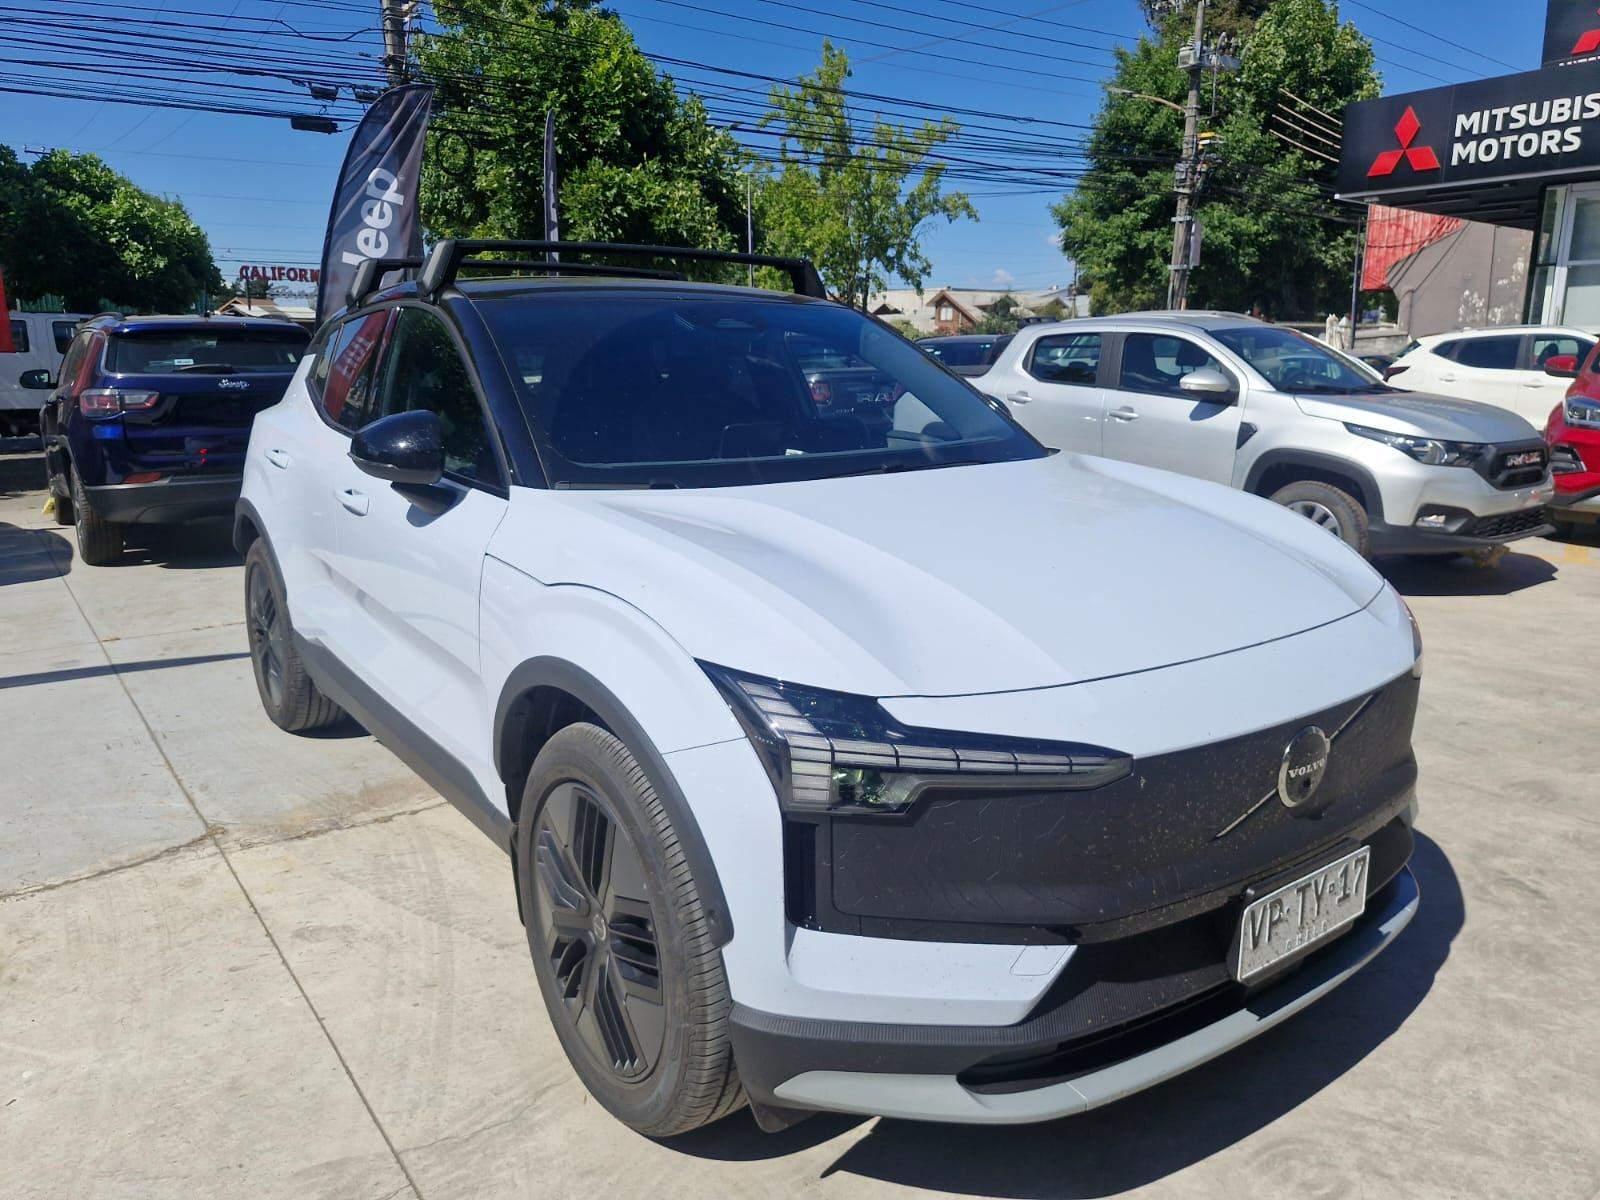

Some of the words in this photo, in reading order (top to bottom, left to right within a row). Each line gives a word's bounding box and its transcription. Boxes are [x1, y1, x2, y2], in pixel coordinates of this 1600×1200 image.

[1454, 92, 1600, 138] MITSUBIS
[1450, 126, 1582, 167] MOTORS
[1288, 758, 1325, 778] VOLVO
